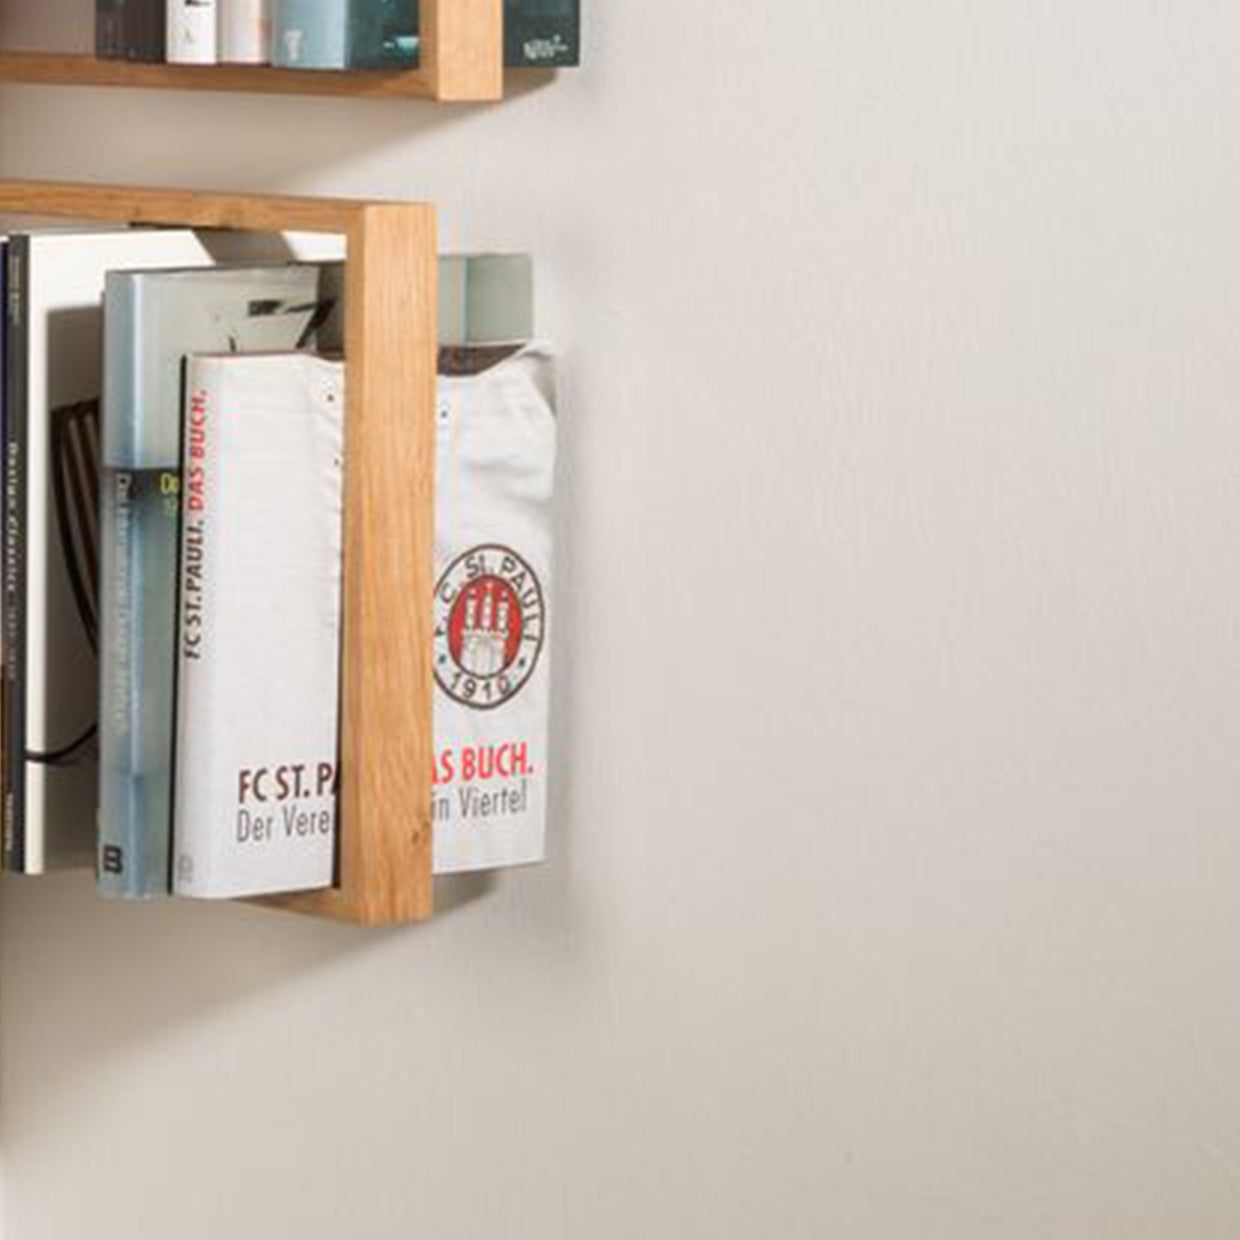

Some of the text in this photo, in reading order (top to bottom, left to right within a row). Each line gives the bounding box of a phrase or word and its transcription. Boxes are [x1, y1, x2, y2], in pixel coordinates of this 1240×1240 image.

[183, 390, 207, 660] FC ST. PAULI. DAS BUCH.
[499, 556, 539, 642] PAULI
[450, 672, 511, 700] 1910
[462, 743, 534, 780] BUCH.
[238, 768, 267, 803] FC
[275, 764, 310, 800] ST.
[458, 780, 527, 818] Viertel
[236, 809, 273, 843] Der
